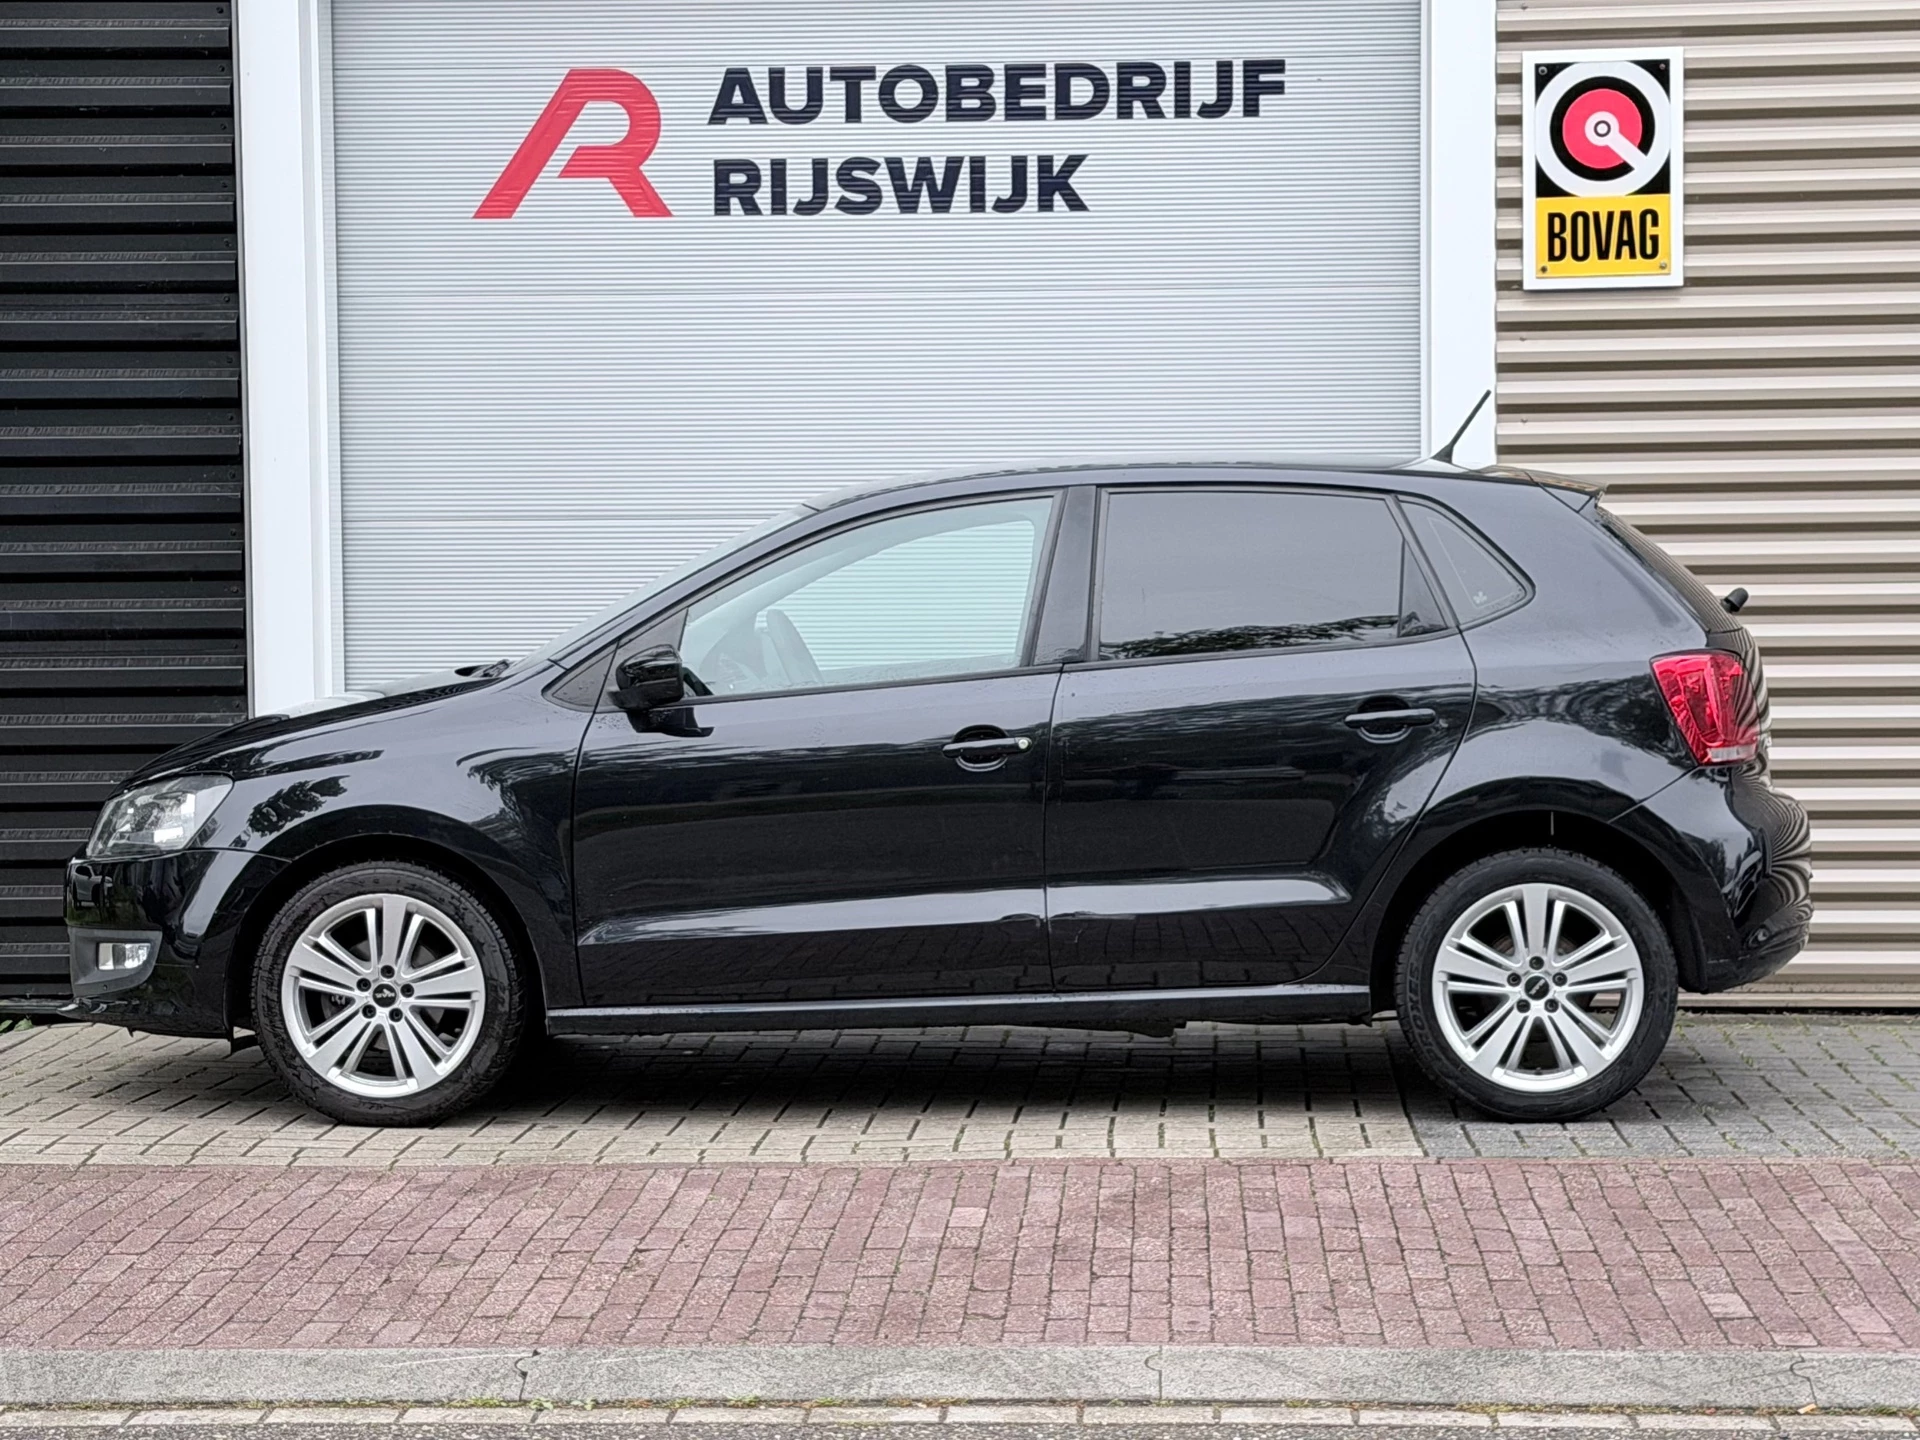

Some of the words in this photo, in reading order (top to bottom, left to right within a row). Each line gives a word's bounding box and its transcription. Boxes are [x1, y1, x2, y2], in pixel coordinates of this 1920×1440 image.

[708, 60, 1285, 125] AUTOBEDRIJF
[714, 154, 1088, 216] RIJSWIJK
[1547, 208, 1659, 262] BOVAG
